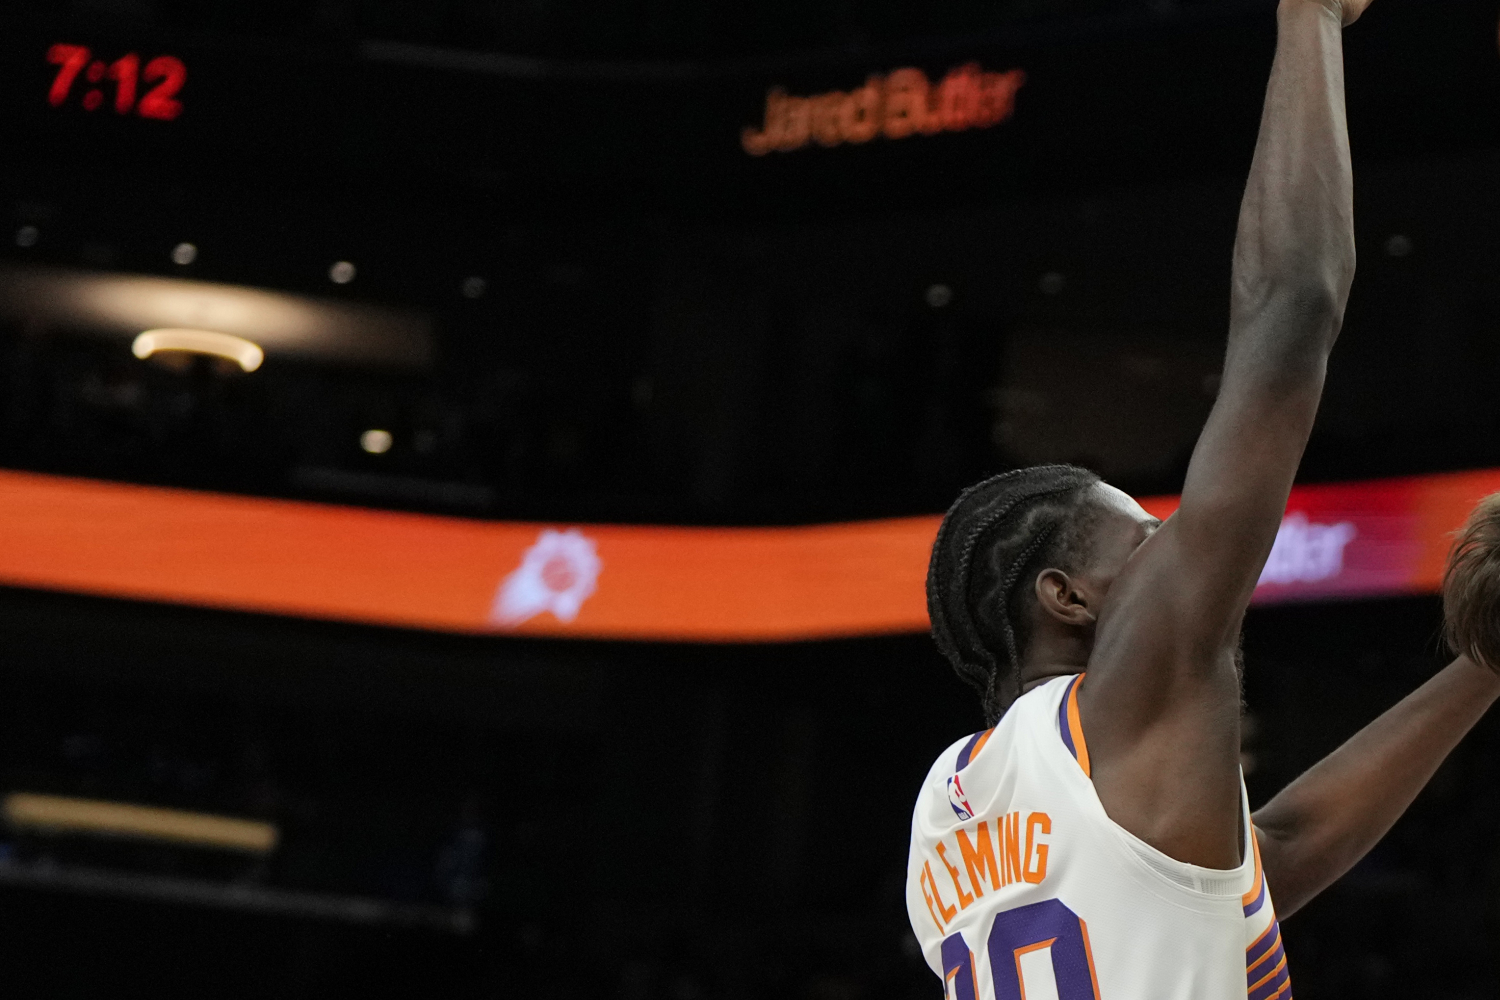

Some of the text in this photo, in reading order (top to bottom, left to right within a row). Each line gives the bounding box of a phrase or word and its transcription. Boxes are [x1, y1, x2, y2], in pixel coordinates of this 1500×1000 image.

[47, 43, 188, 120] 7:12
[741, 62, 1025, 156] Jared Butler
[919, 810, 1052, 937] FLEMING
